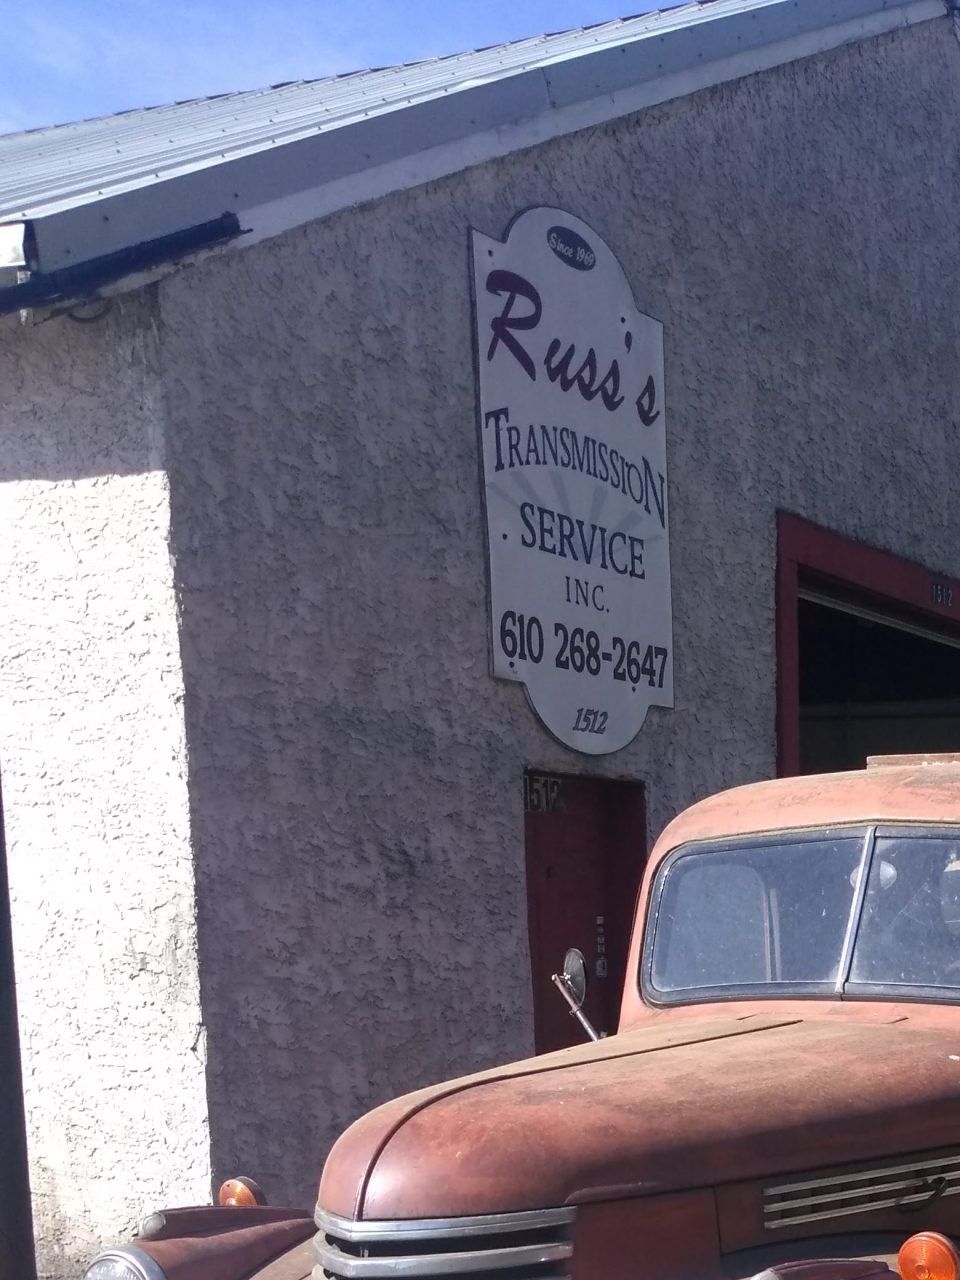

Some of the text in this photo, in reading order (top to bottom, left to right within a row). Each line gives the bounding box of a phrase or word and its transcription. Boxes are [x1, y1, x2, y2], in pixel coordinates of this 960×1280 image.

[550, 233, 594, 266] Since 1969
[486, 270, 660, 427] Russ's
[485, 408, 665, 529] TRANSMISSION
[520, 502, 645, 579] SERVICE
[565, 576, 610, 613] INC.
[501, 611, 668, 688] 610 268-2647
[572, 707, 609, 735] 1512
